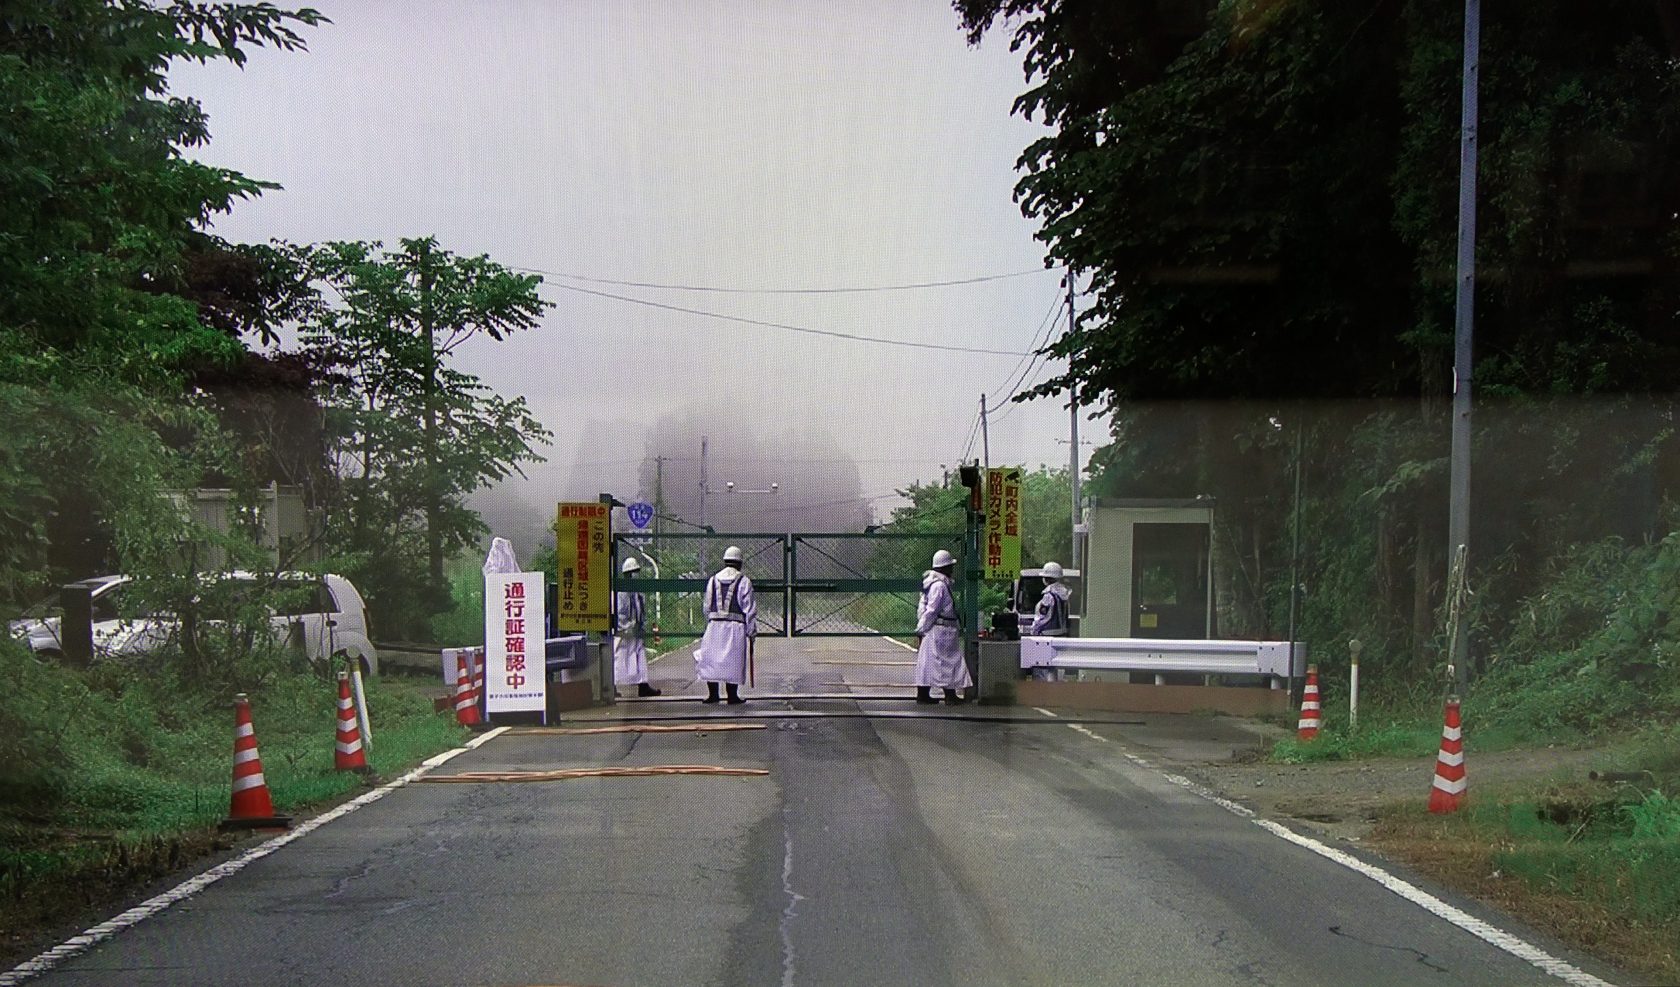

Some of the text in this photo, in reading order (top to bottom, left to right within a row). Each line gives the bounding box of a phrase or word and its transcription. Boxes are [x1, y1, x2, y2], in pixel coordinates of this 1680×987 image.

[988, 471, 1002, 568] 防犯カメラ作動中
[1005, 486, 1018, 536] 町内全域
[593, 520, 604, 553] この先
[563, 567, 573, 611] 通行止め
[505, 582, 526, 690] 通行証確認中
